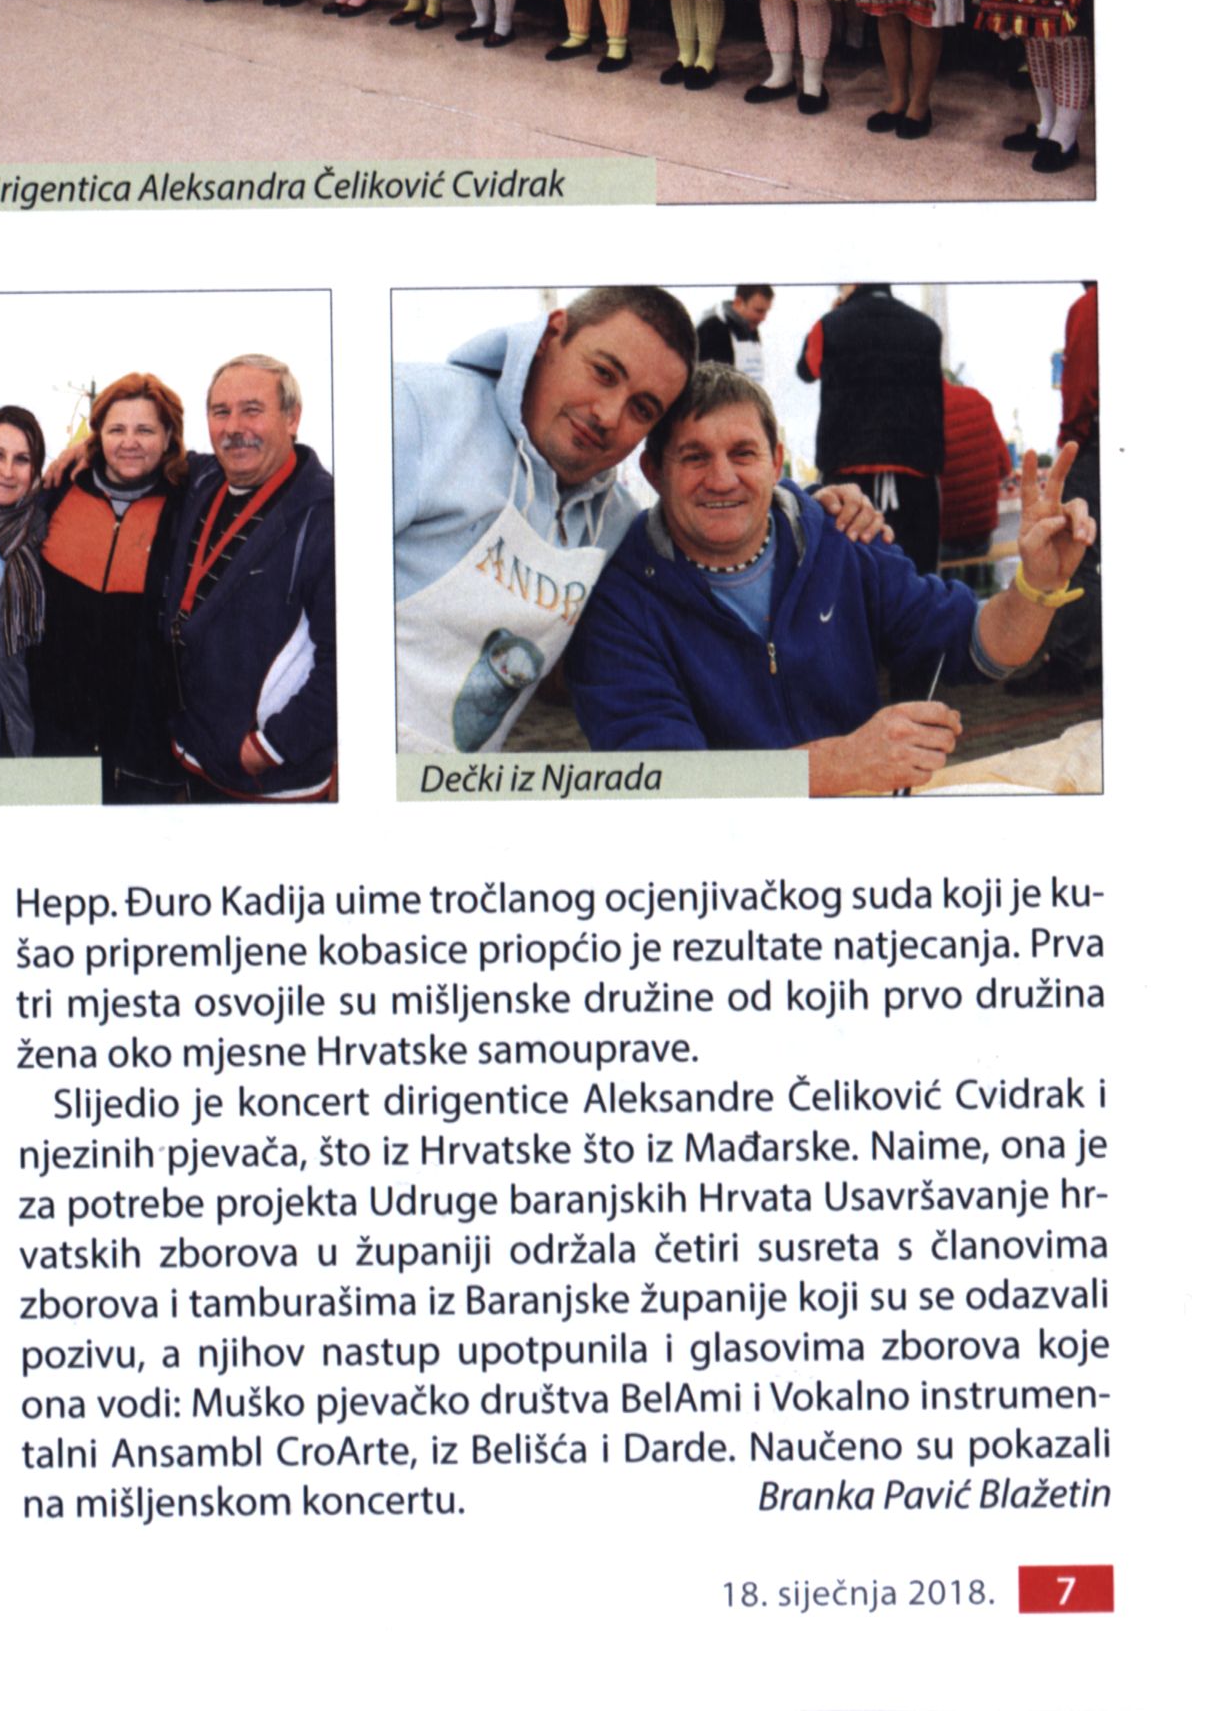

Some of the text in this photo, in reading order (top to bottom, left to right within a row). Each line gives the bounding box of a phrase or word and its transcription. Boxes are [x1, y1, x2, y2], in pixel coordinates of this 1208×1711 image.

[137, 171, 306, 201] Aleksandra
[314, 166, 445, 200] Čeliković
[452, 168, 565, 198] Cvidrak
[421, 762, 662, 799] Dečki iz Njarada
[16, 875, 1104, 926] Hepp. Đuro Kadija uime tročlanog ocjenjivačkog suda koji je ku-
[17, 927, 1104, 976] šao pripremljene kobasice priopćio je rezultate natjecanja. Prva
[759, 1477, 1111, 1511] Branka Pavić Blažetin
[723, 1579, 995, 1614] 18. siječnja 2018.
[1055, 1576, 1077, 1606] 7
